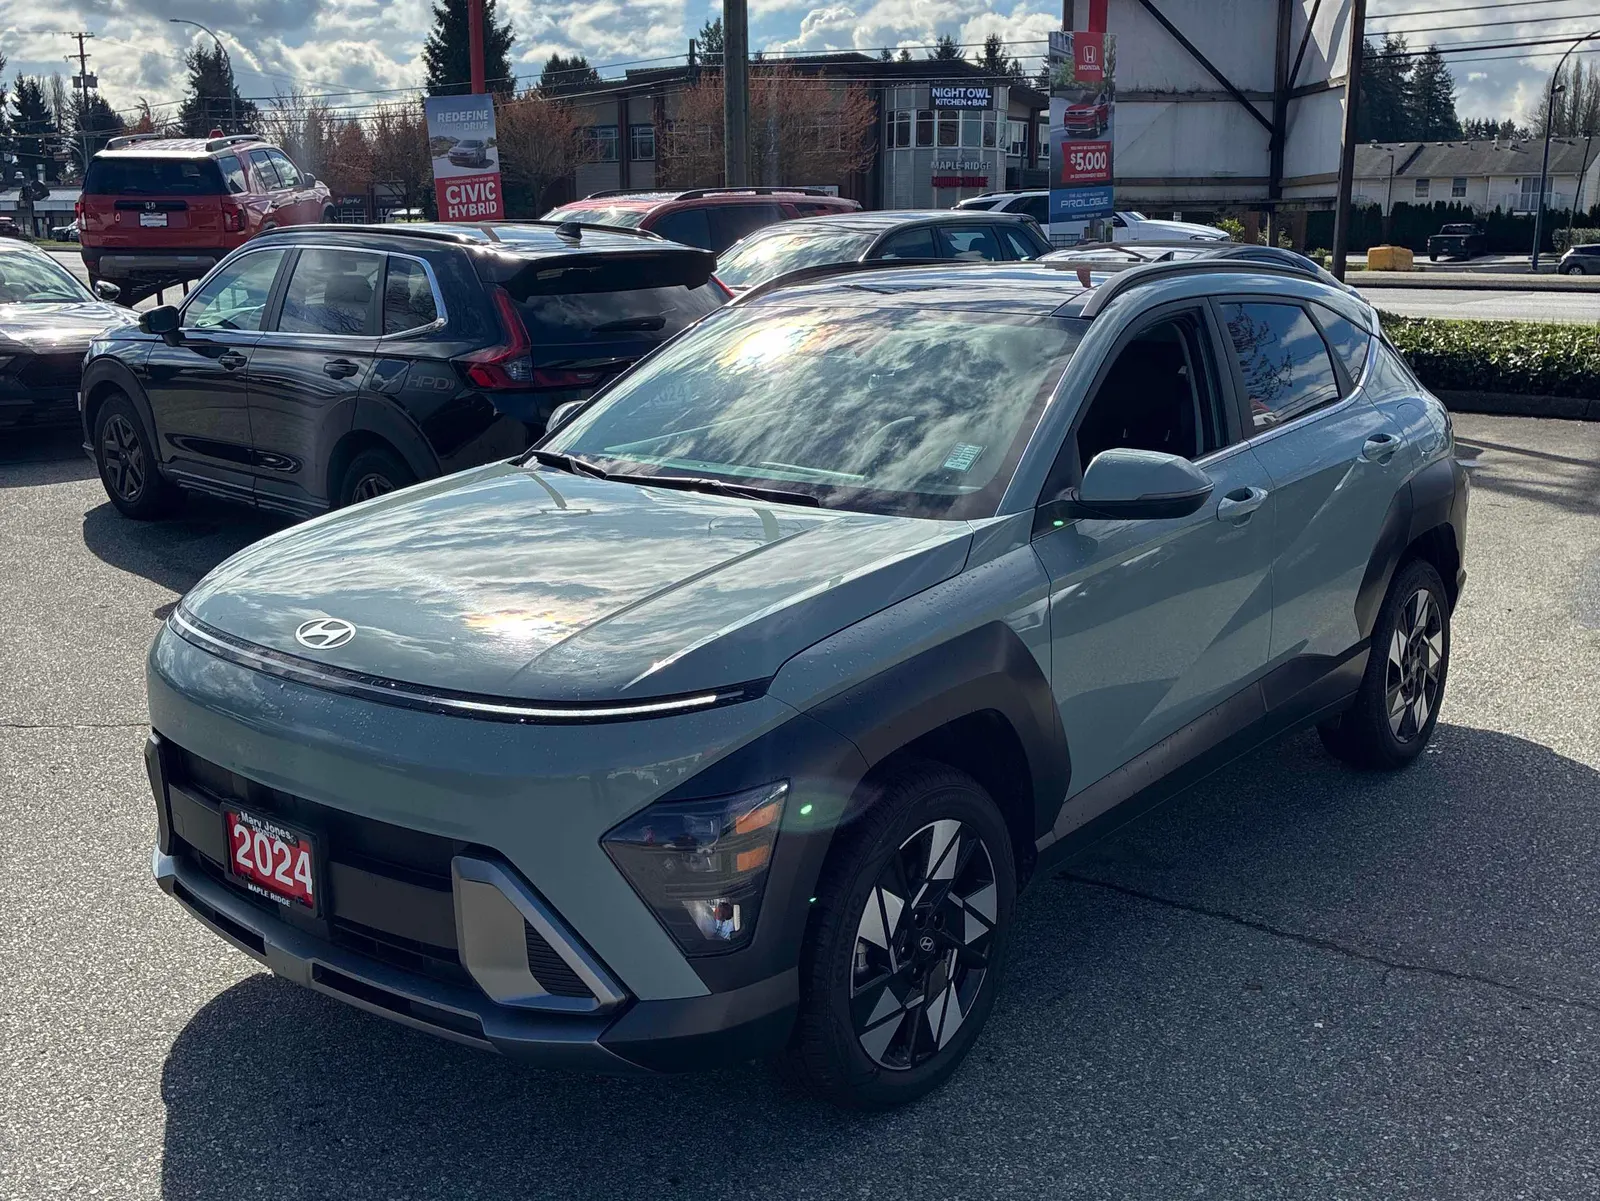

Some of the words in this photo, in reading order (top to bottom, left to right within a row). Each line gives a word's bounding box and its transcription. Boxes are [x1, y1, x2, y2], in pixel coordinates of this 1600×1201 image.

[932, 88, 966, 98] NIGHT
[967, 88, 992, 98] OWL
[935, 98, 967, 106] KITCHEN
[437, 109, 489, 123] REDEFINE
[463, 121, 489, 131] DRIVE
[930, 161, 960, 170] MAPLE
[1070, 151, 1107, 171] $5,000
[445, 181, 497, 205] CIVIC
[448, 201, 497, 219] HYBRID
[1060, 196, 1109, 209] PROLOGUE
[406, 375, 451, 390] HPD
[240, 811, 262, 828] Mary
[264, 821, 291, 840] Jones
[233, 823, 313, 895] 2024
[247, 883, 269, 899] MAPLE
[270, 892, 291, 908] RIDGE
